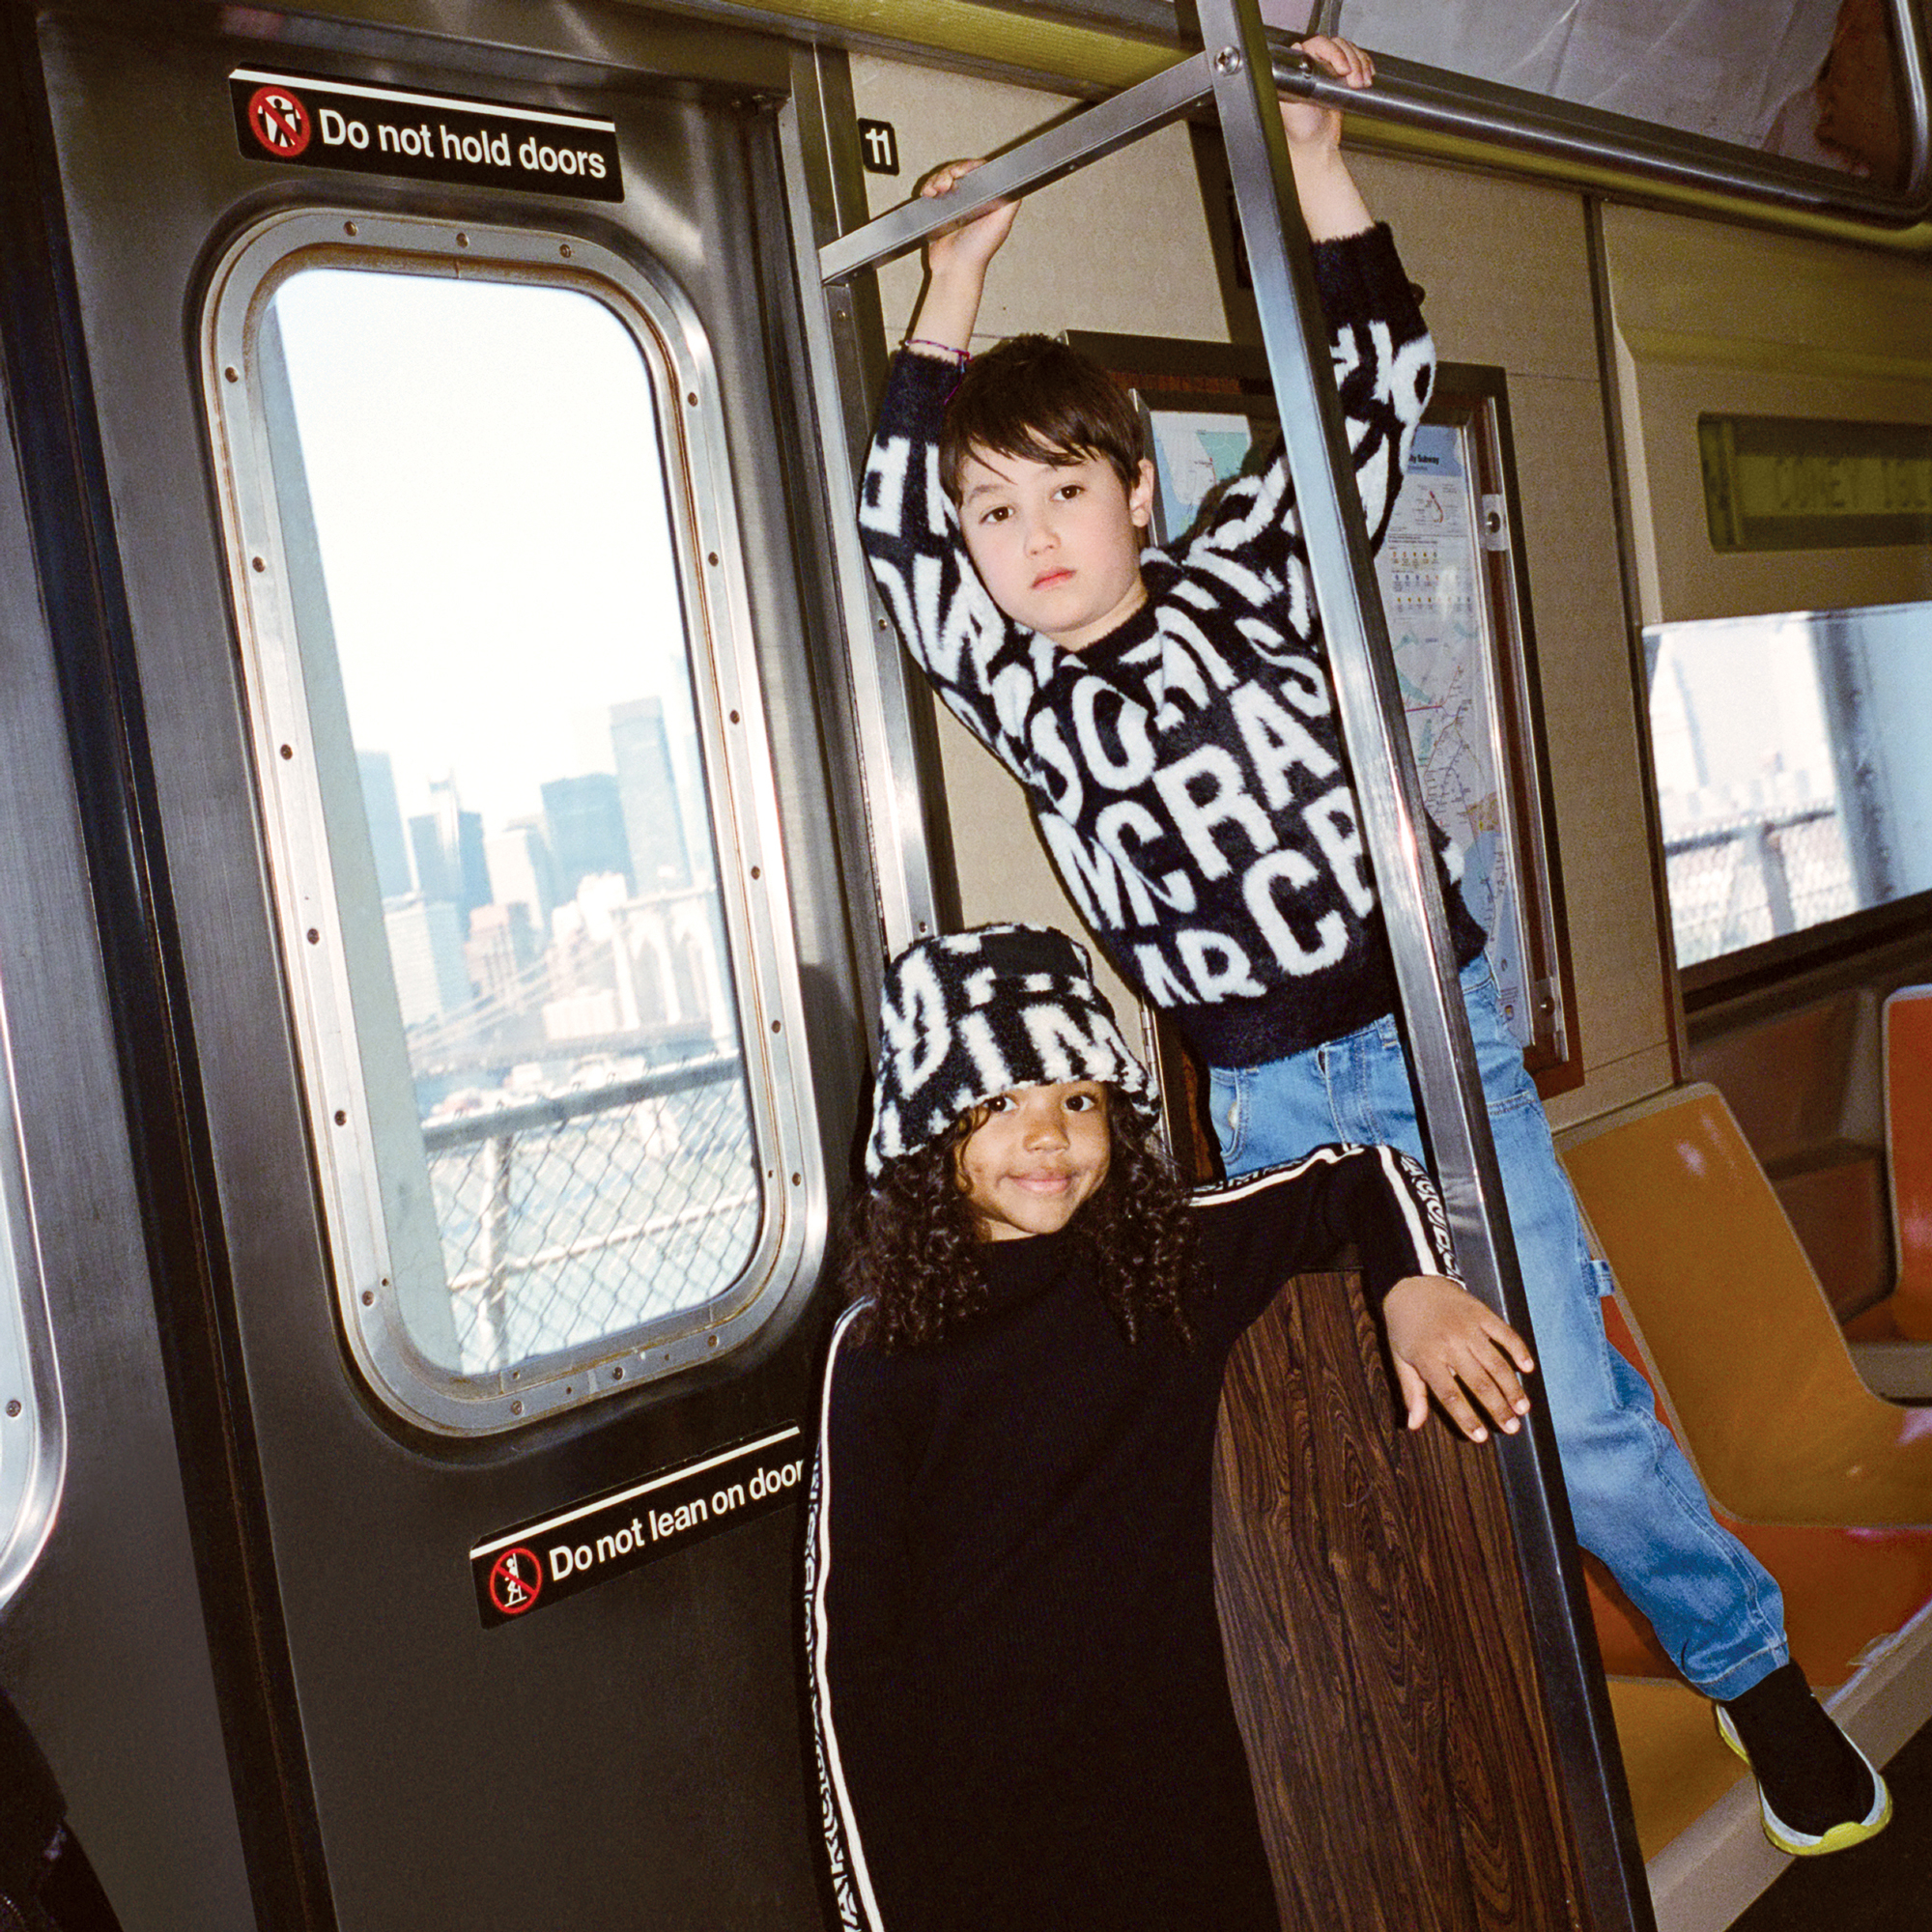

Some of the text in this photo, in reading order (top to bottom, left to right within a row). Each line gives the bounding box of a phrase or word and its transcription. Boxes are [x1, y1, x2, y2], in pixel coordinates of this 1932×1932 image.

[318, 108, 607, 179] Do not hold doors
[865, 128, 892, 166] 11
[549, 1545, 593, 1581] Do
[596, 1518, 645, 1563] not
[648, 1498, 708, 1542] lean
[711, 1484, 746, 1517] on
[749, 1459, 804, 1500] door
